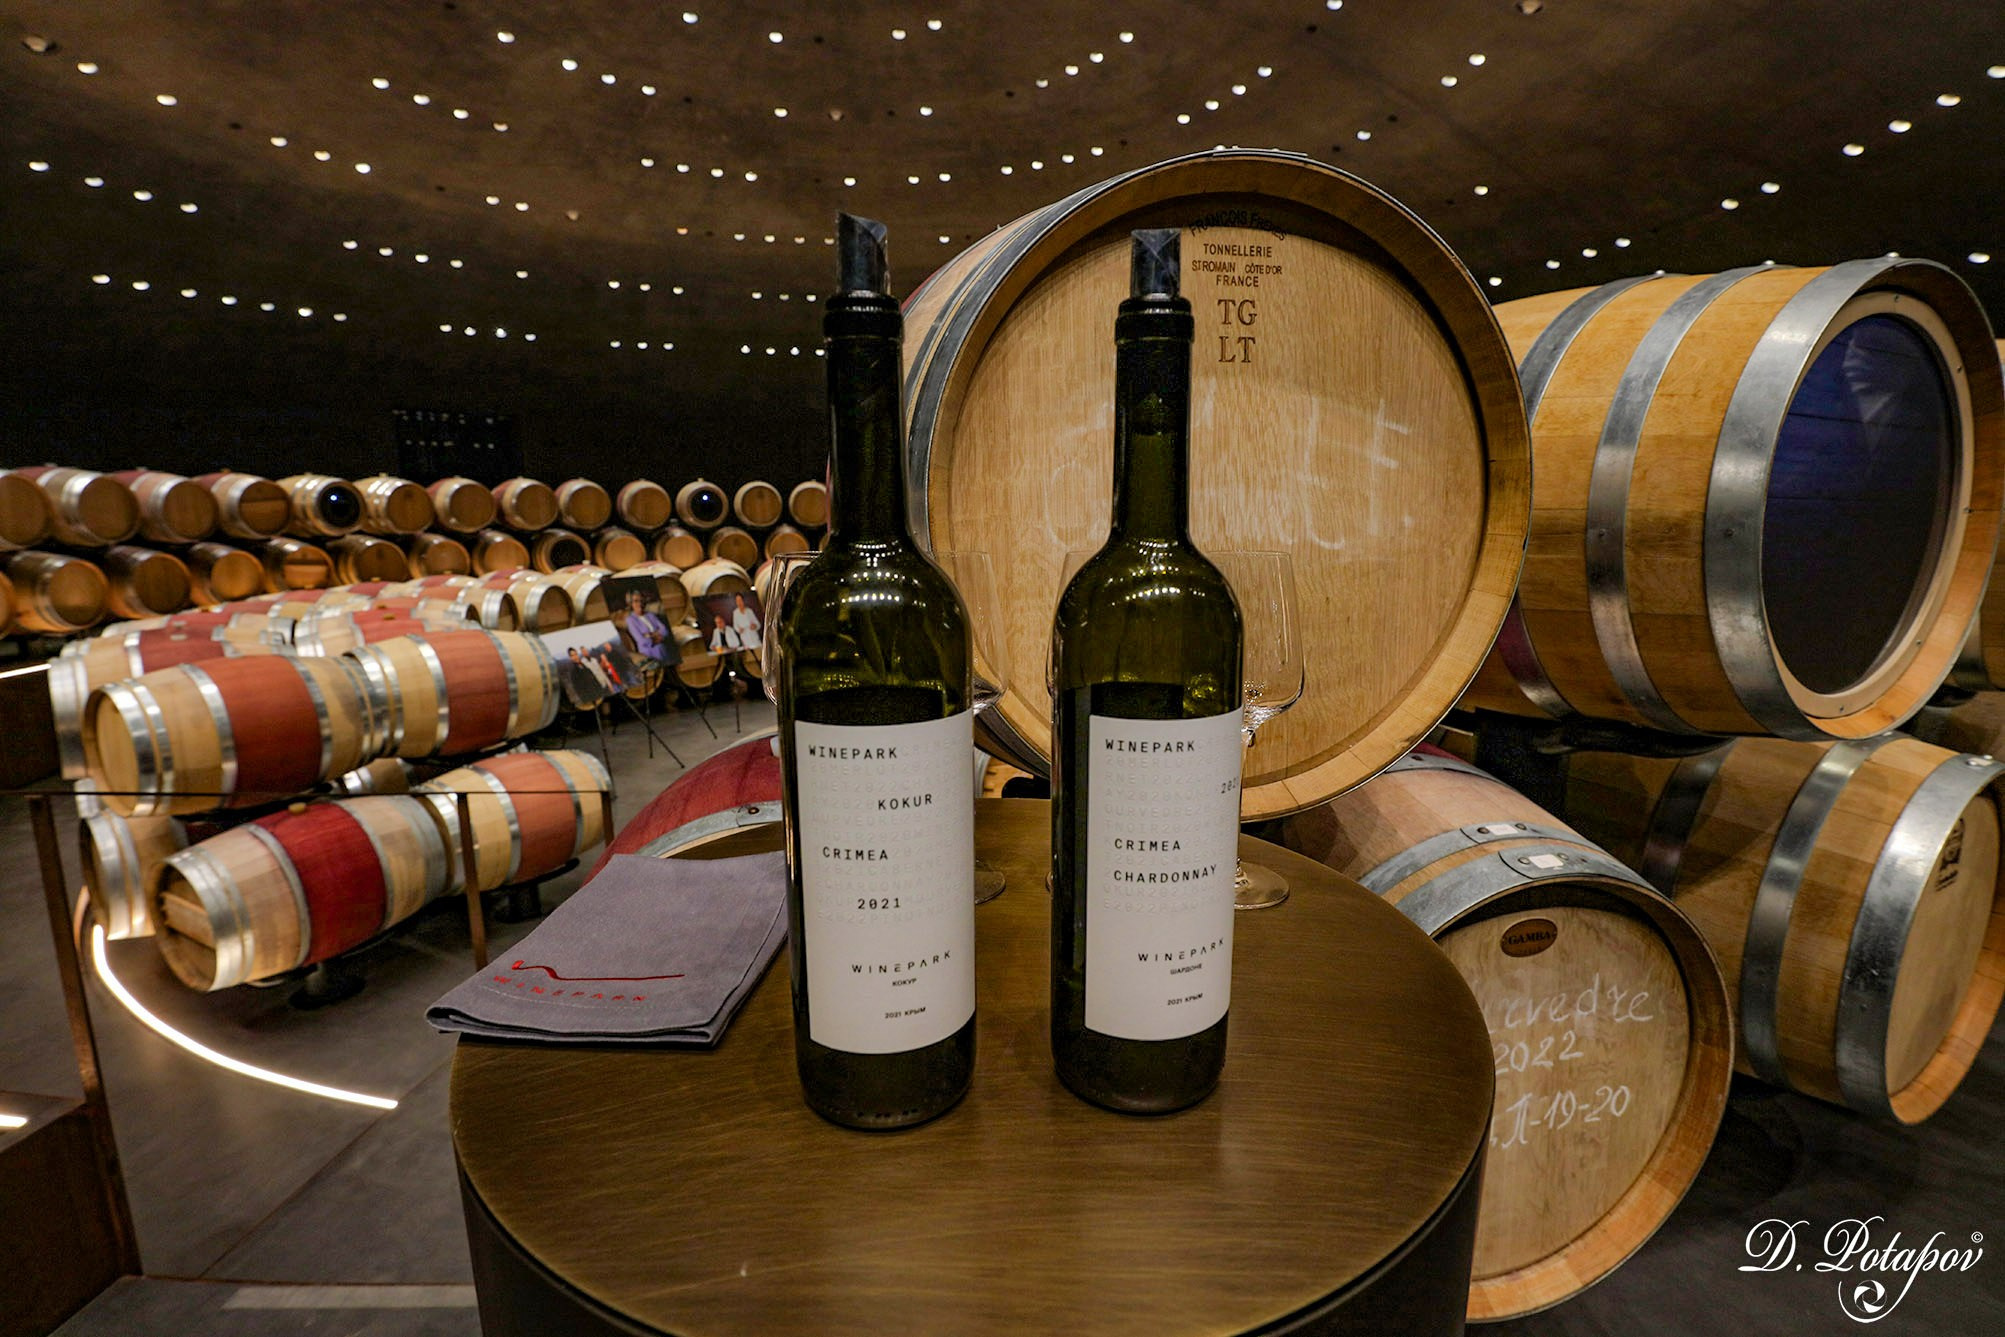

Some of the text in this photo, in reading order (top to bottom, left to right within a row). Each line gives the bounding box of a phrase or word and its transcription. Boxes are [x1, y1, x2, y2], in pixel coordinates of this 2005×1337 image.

[1203, 243, 1272, 257] TONNELLERIE
[1216, 275, 1259, 287] FRANCE
[1217, 299, 1257, 326] TG
[1218, 336, 1256, 363] LT
[808, 744, 898, 759] WINEPARK
[1105, 738, 1196, 753] WINEPARK
[877, 793, 933, 810] KOKUR
[1114, 838, 1181, 851] CRIMEA
[822, 846, 889, 860] CRIMEA
[1113, 864, 1217, 883] CHARDONNAY
[857, 898, 901, 909] 2021
[1508, 931, 1551, 945] GAMBA
[1138, 937, 1224, 962] WINEPARK
[852, 950, 951, 974] WINEPARK
[892, 978, 917, 986] КОКУР
[1167, 998, 1183, 1006] 2021
[884, 1006, 926, 1019] 2021 КРЫМ
[1494, 1030, 1584, 1075] 2022
